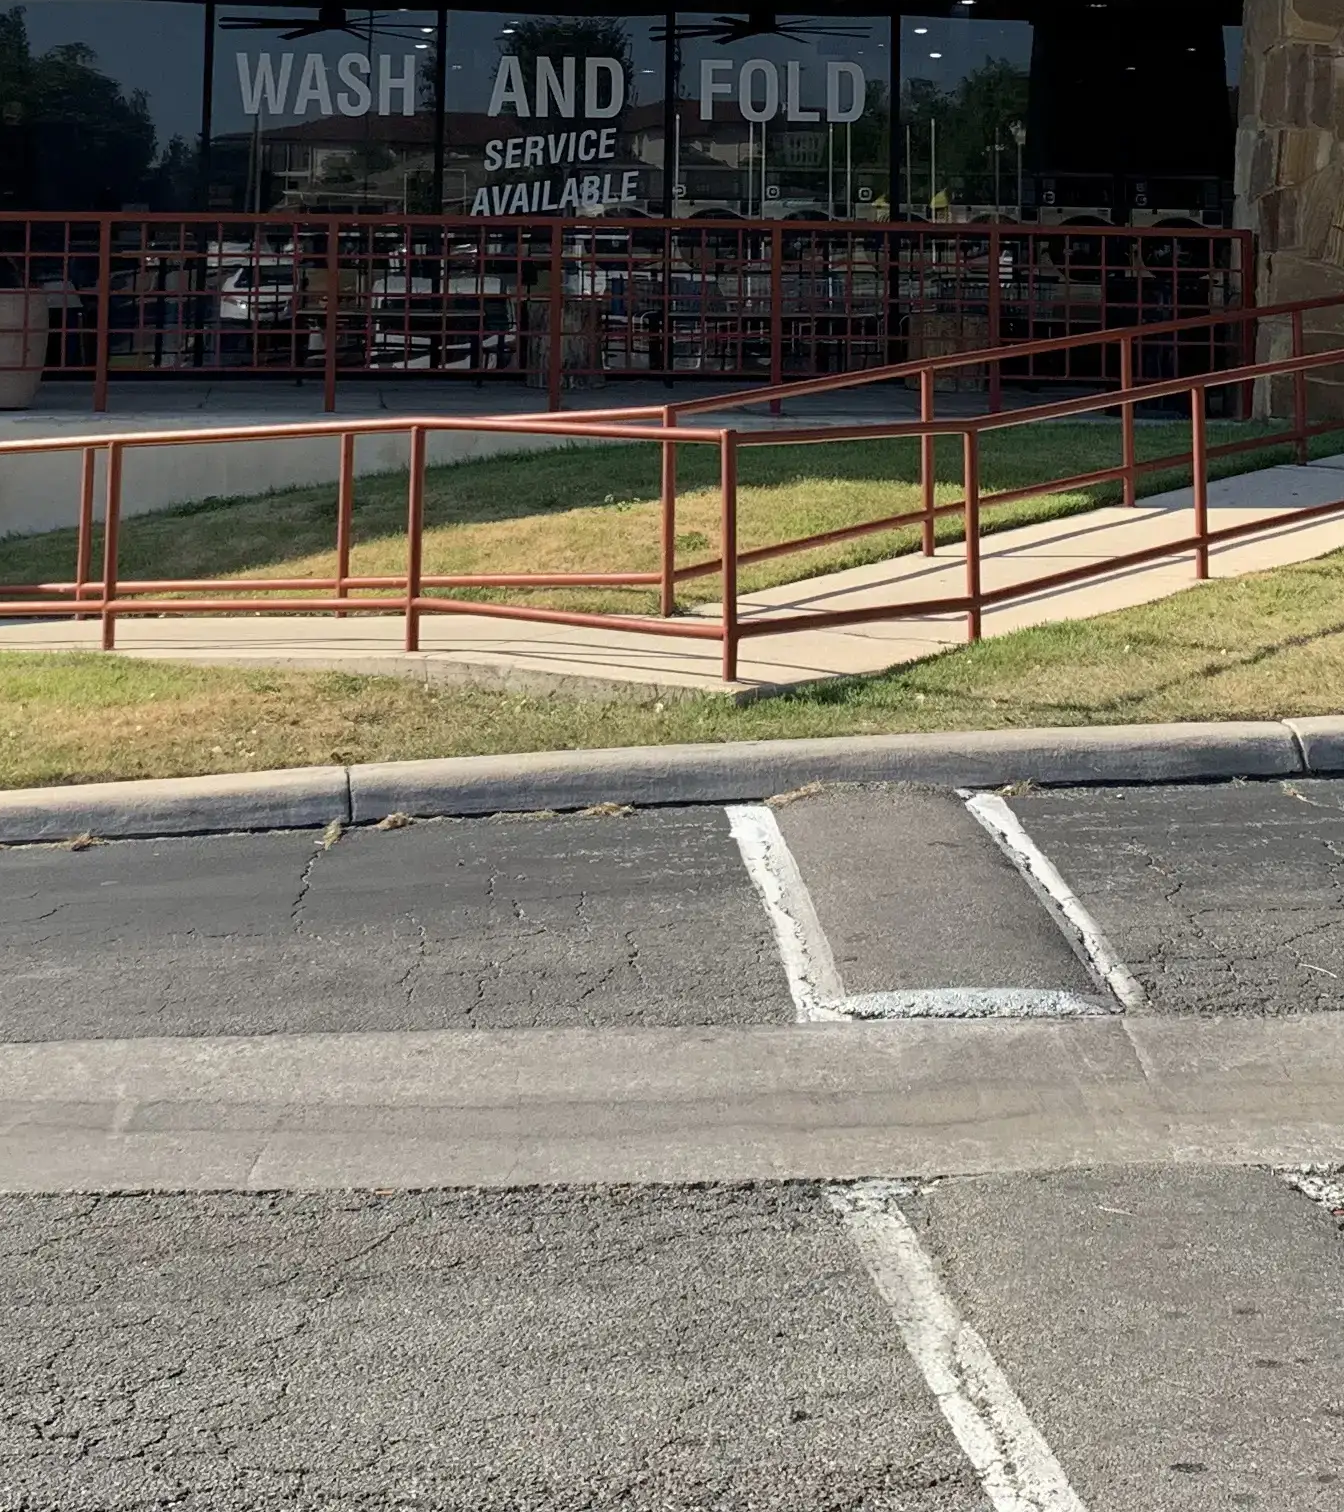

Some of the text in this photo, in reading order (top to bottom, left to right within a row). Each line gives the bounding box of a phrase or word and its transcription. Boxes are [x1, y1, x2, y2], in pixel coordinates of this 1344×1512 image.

[236, 52, 866, 123] WASH AND FOLD
[484, 128, 616, 172] SERVICE
[470, 171, 639, 217] AVAILABLE
